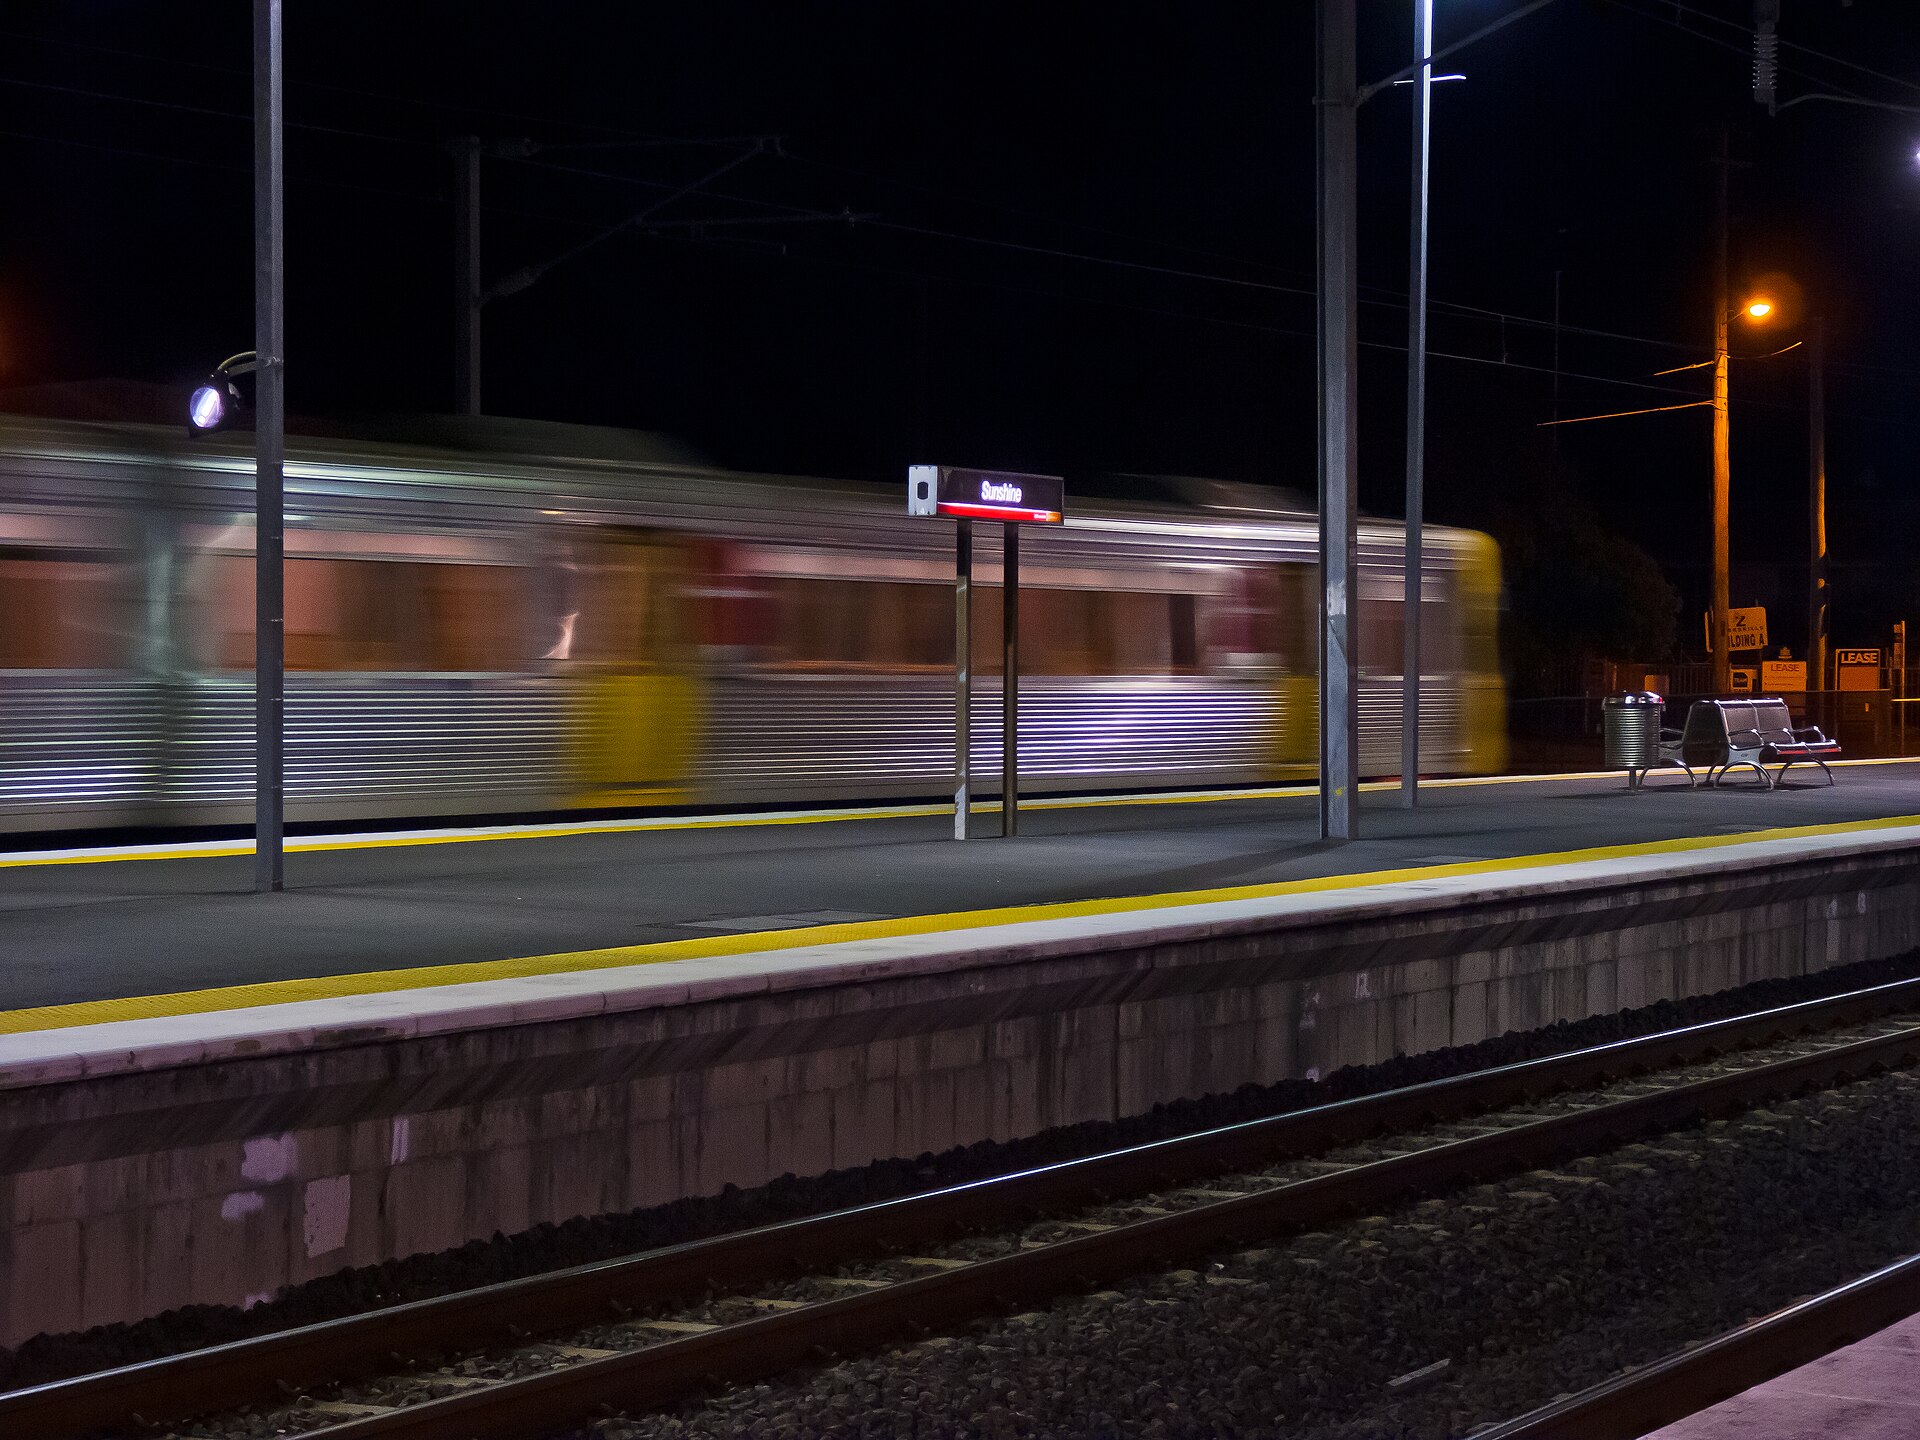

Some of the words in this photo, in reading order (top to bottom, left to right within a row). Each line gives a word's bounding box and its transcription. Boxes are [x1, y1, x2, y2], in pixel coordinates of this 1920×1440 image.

[980, 480, 1022, 503] Sunshine
[1727, 633, 1756, 648] ILDING
[1759, 633, 1765, 646] A
[1841, 652, 1877, 663] LEASE
[1771, 663, 1800, 672] LEASE
